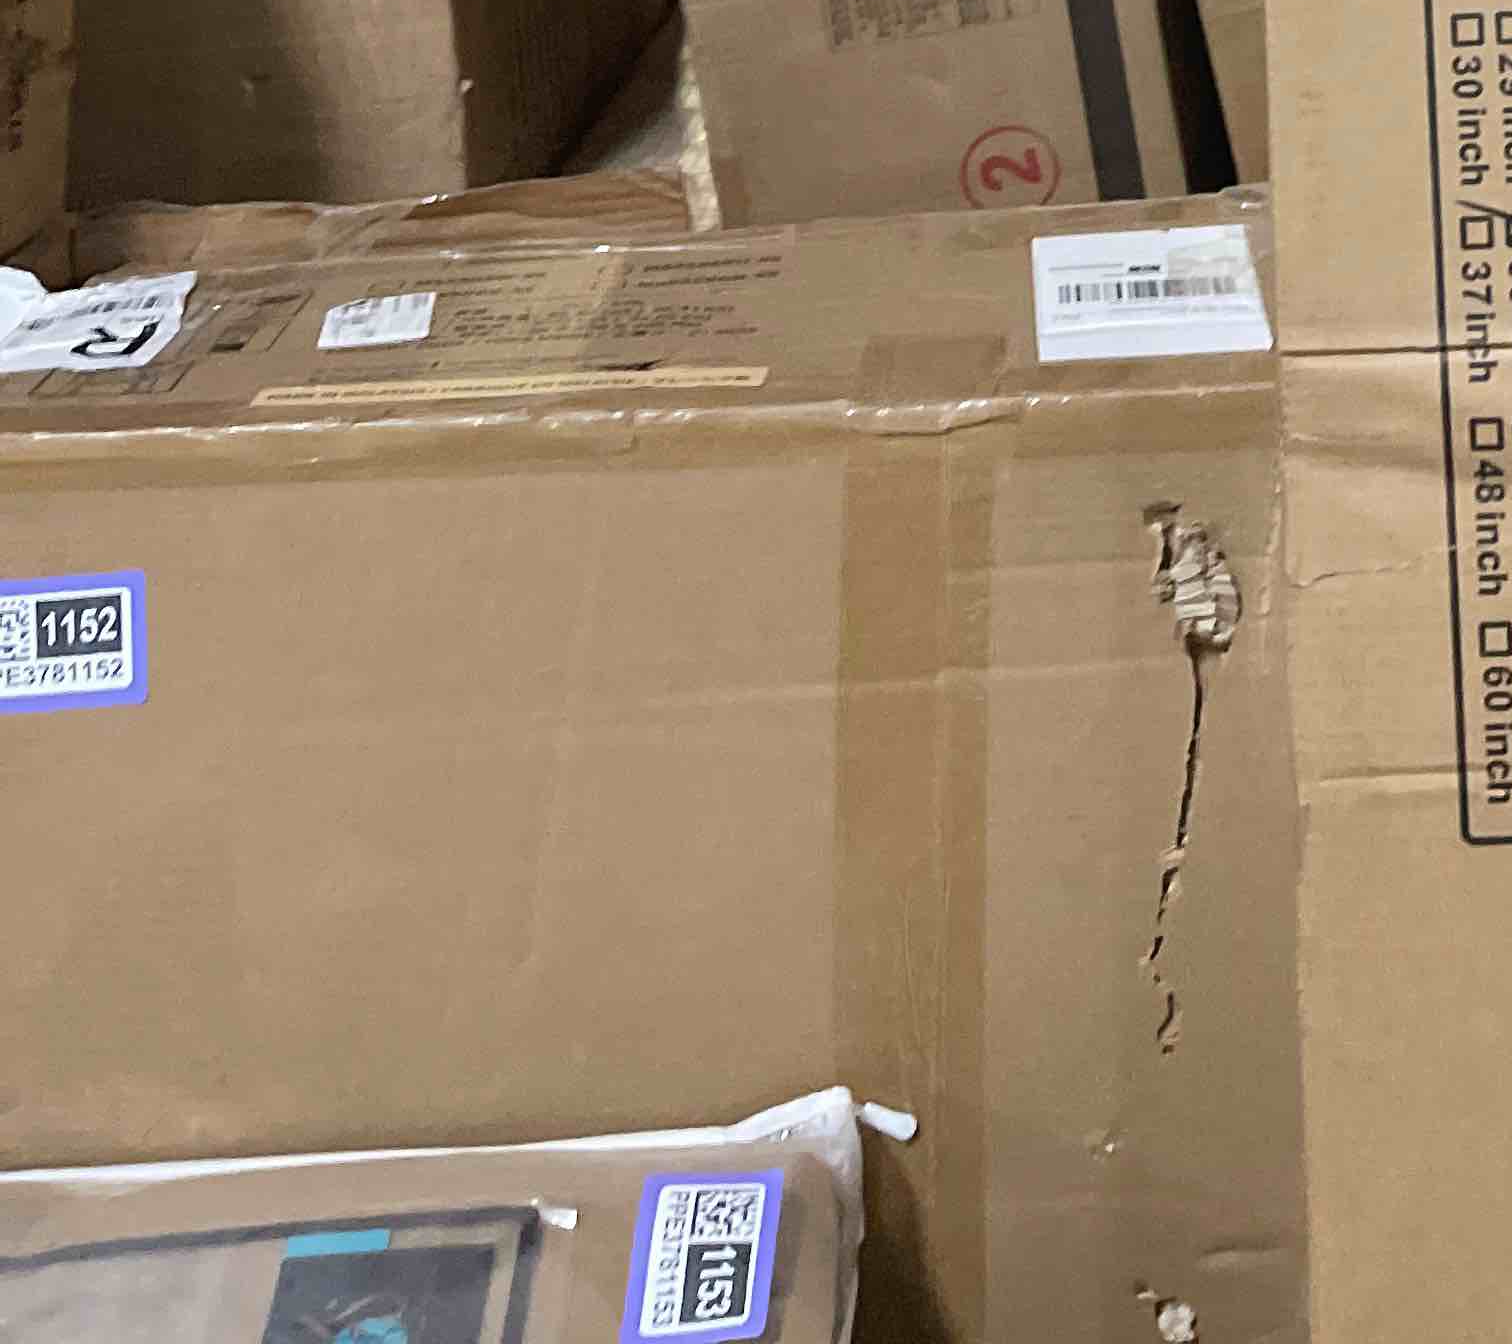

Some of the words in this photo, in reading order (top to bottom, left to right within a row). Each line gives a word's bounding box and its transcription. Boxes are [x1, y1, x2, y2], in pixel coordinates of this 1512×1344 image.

[1452, 56, 1483, 98] 30
[982, 135, 1041, 192] 2
[1458, 108, 1490, 186] inch
[1461, 262, 1493, 305] 37
[1466, 312, 1498, 383] inch
[1473, 459, 1505, 503] 48
[1476, 512, 1508, 595] inch
[41, 605, 119, 648] 1152
[0, 657, 124, 688] E3781152
[694, 1245, 738, 1319] 1153
